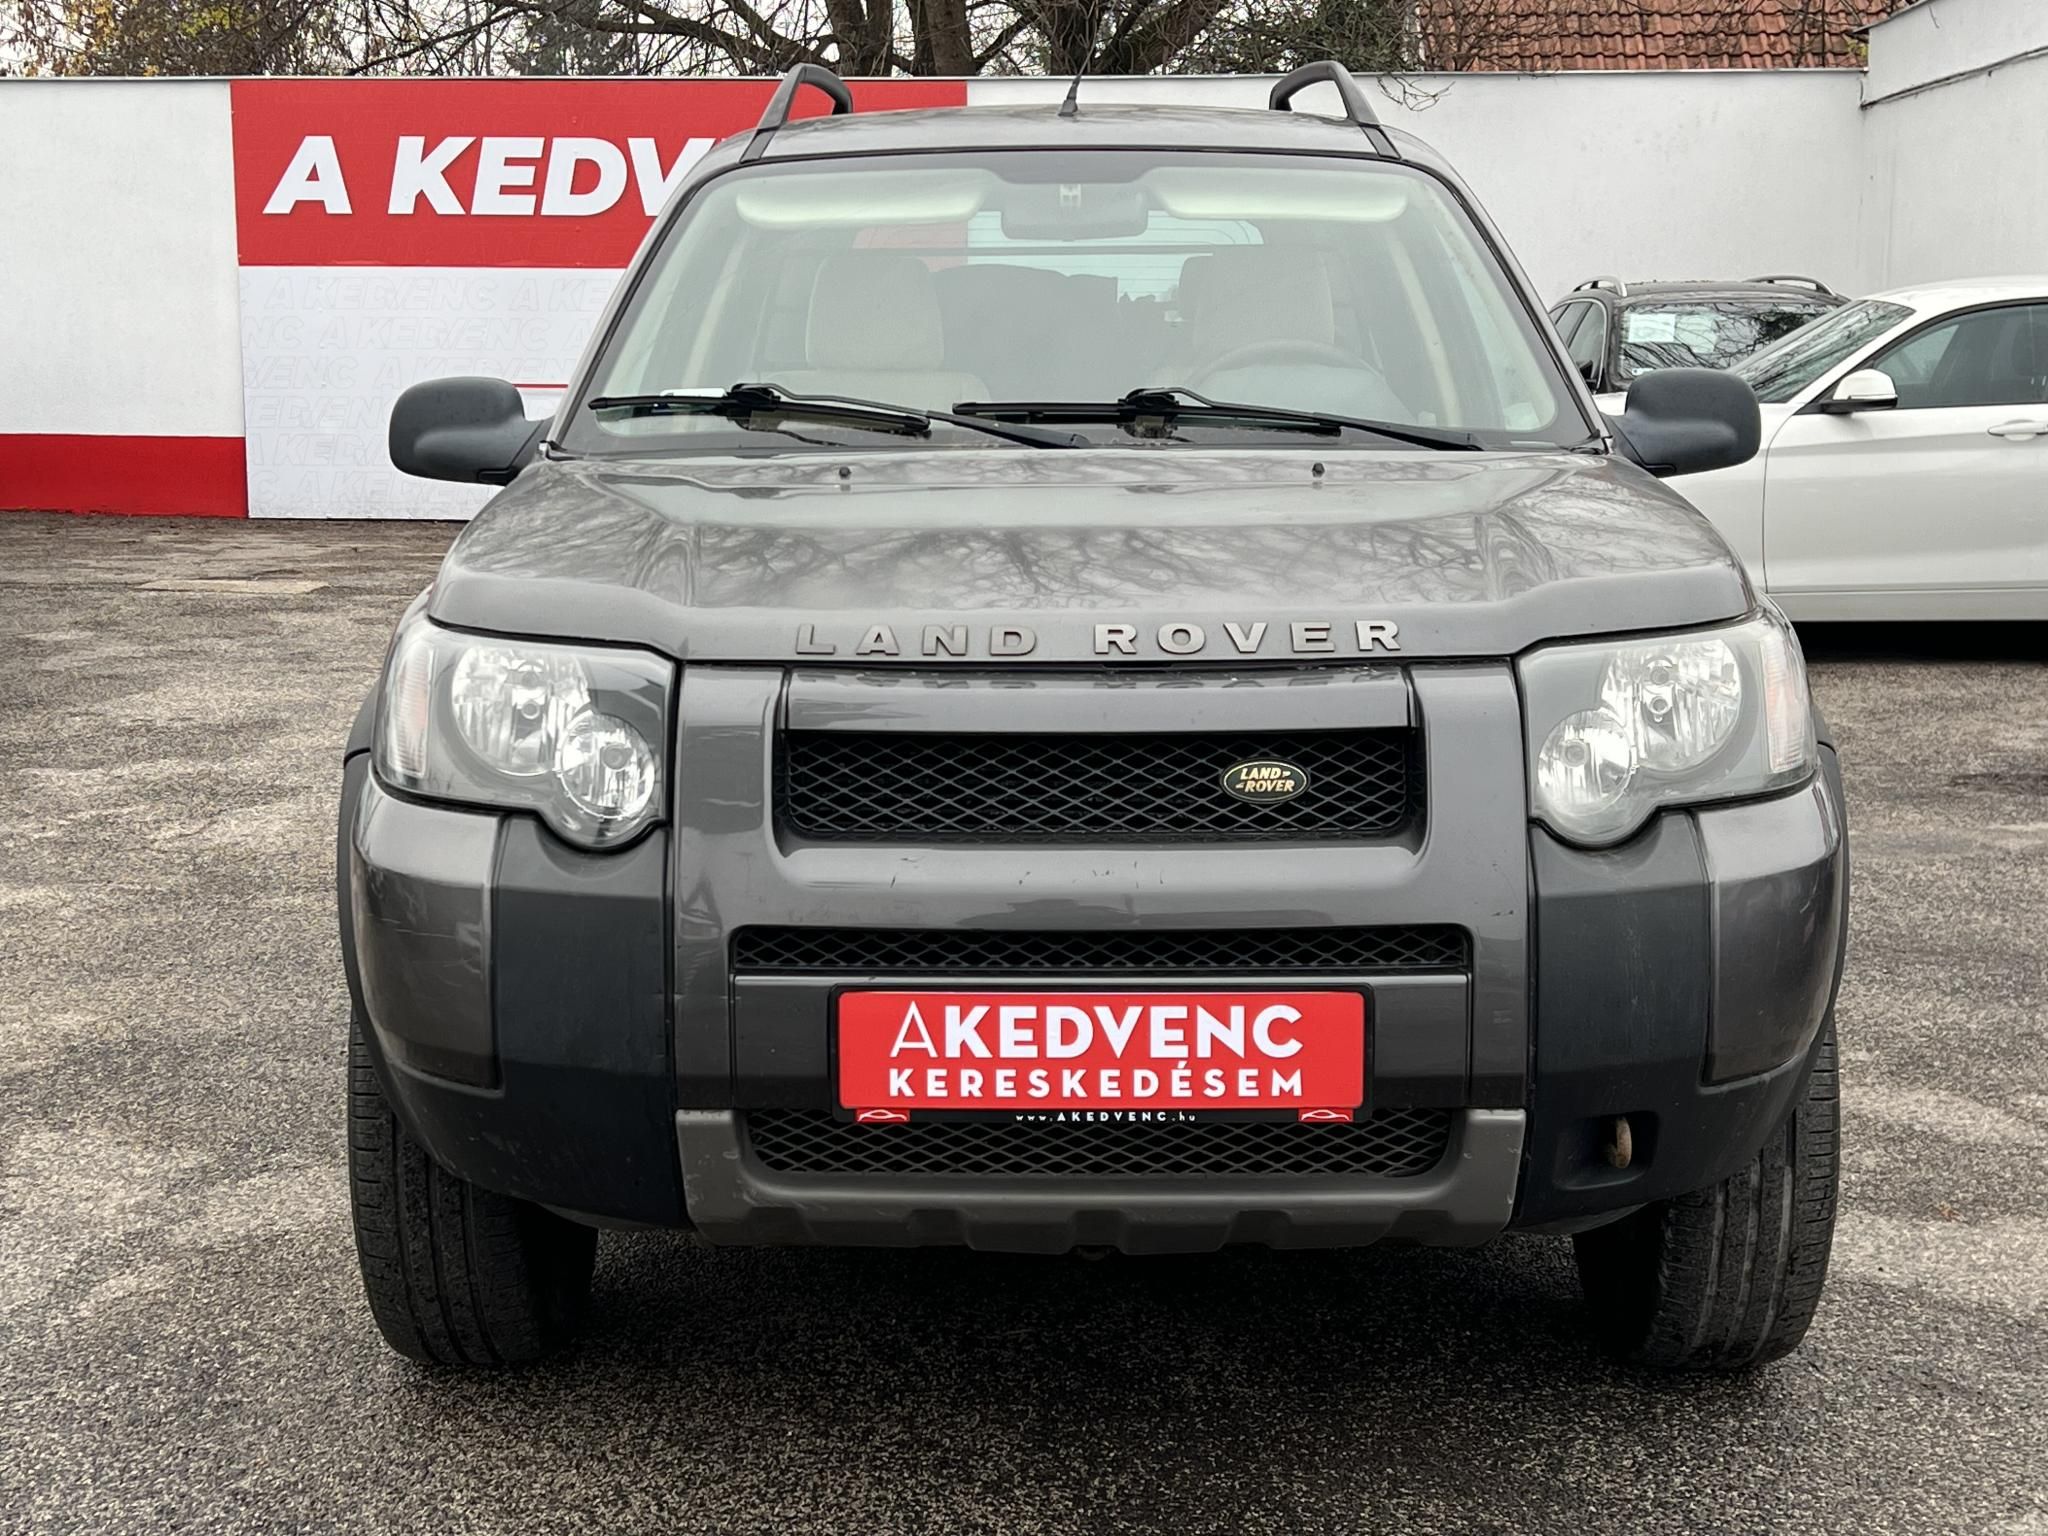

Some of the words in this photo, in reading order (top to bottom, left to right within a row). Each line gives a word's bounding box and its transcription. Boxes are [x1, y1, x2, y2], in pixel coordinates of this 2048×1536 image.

[263, 136, 353, 215] A
[387, 137, 724, 217] KEDV
[795, 624, 1038, 656] LAND
[1093, 619, 1401, 655] ROVER
[1240, 767, 1282, 780] LAND
[1244, 779, 1296, 793] ROVER
[889, 1061, 1303, 1099] KERESKEDÉSEM
[1015, 1110, 1197, 1122] www.AKEDVENC.hu
